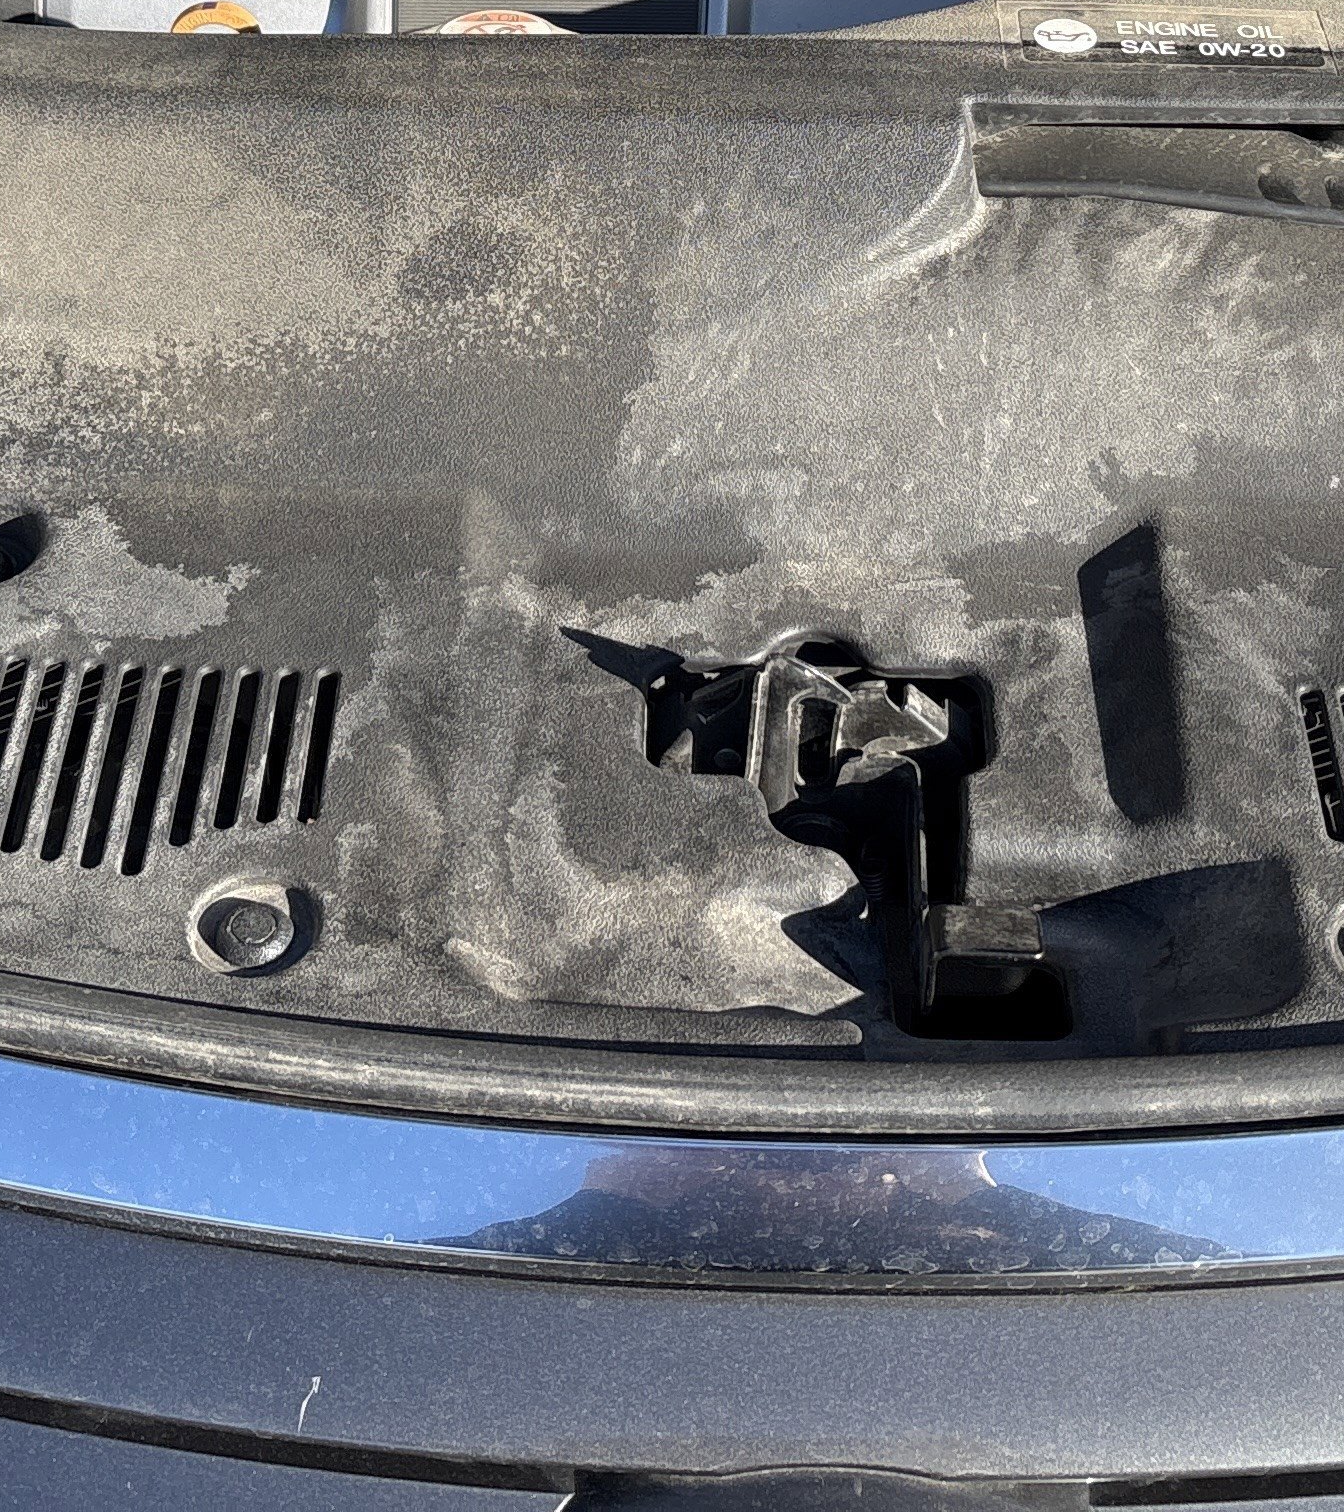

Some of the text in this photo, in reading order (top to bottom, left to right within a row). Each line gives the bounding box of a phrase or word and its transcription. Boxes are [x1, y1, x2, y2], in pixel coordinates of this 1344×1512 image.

[1115, 20, 1284, 39] ENGINE OIL
[1120, 39, 1286, 58] SAE 0W-20
